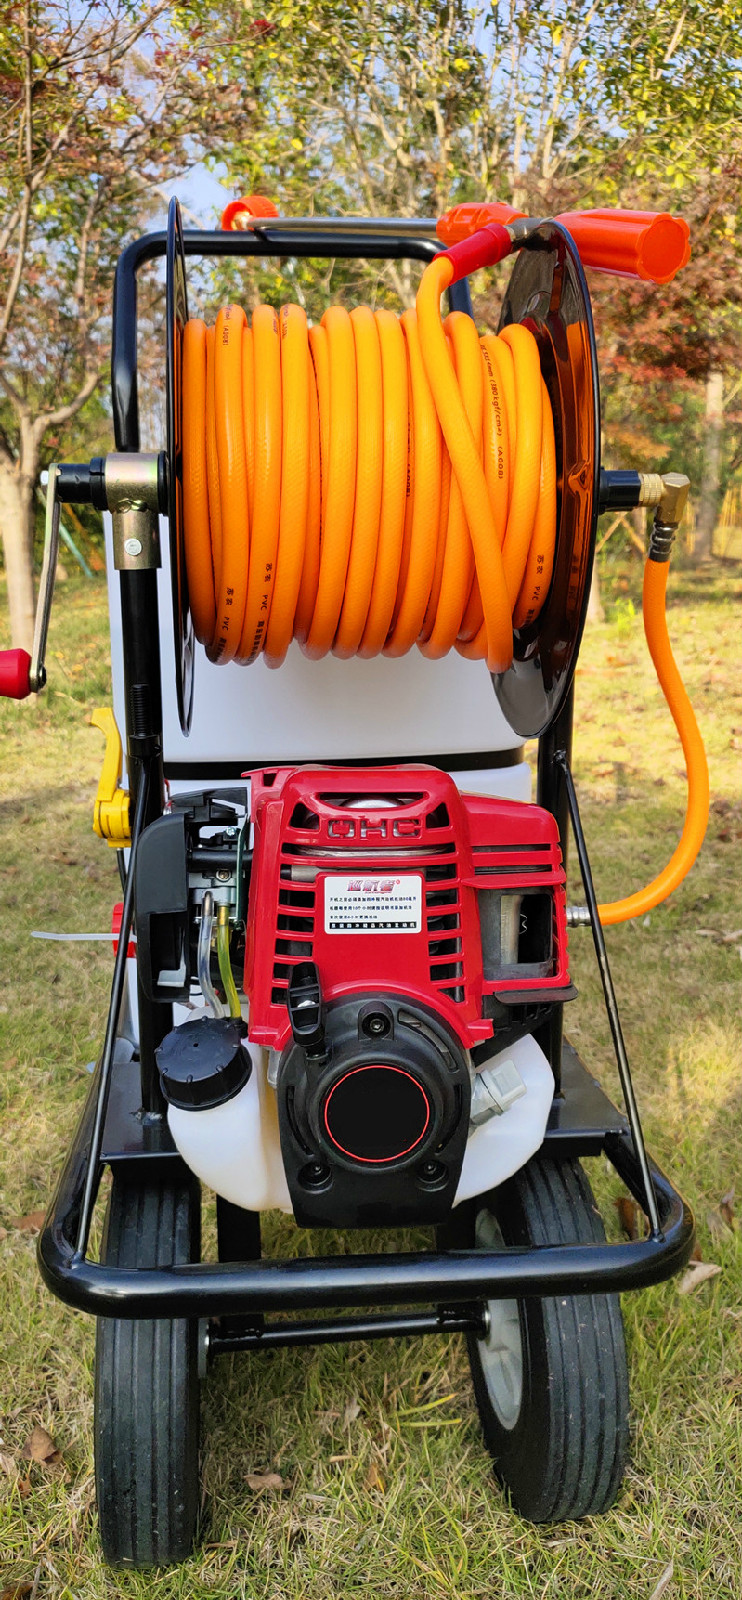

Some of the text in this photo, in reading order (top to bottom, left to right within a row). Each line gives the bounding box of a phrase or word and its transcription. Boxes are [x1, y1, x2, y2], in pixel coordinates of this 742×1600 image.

[532, 586, 541, 601] PVC
[260, 594, 268, 611] PVC
[222, 616, 230, 631] PVC
[327, 818, 420, 839] OHC
